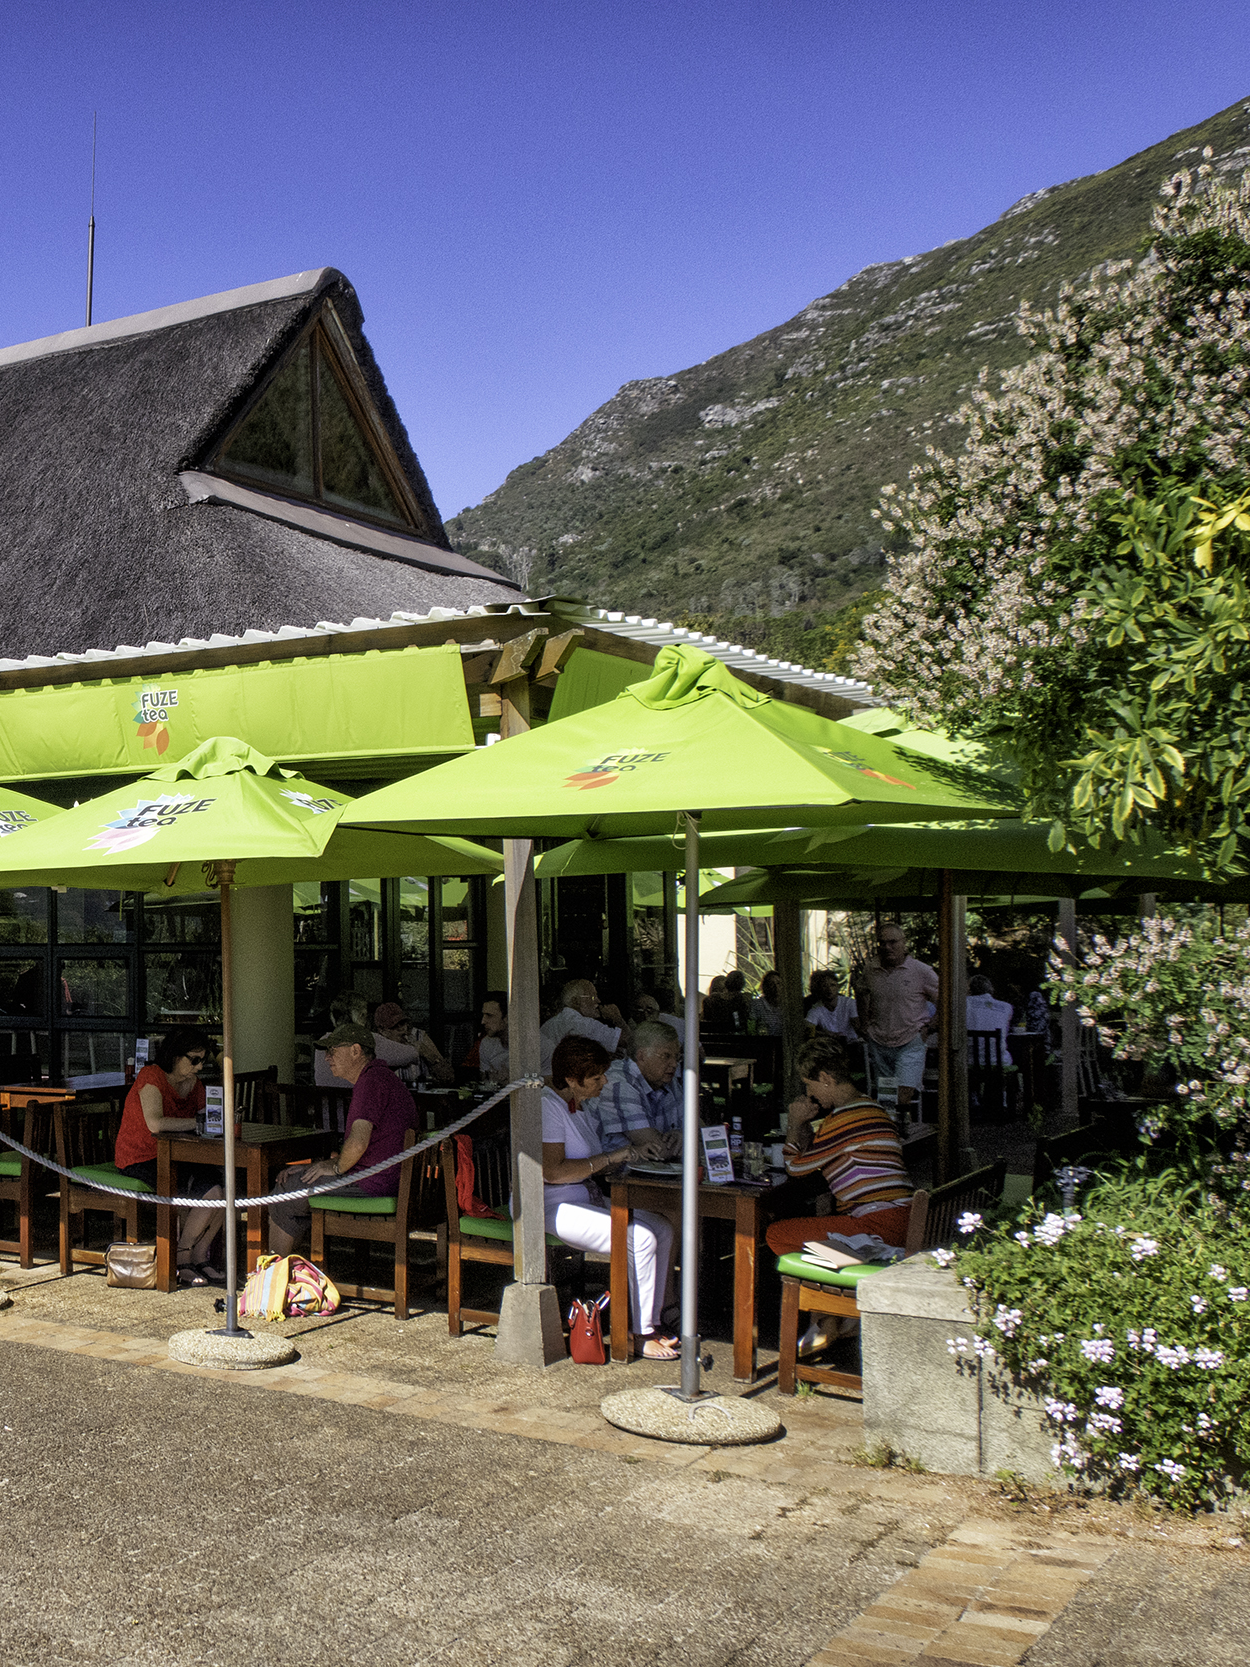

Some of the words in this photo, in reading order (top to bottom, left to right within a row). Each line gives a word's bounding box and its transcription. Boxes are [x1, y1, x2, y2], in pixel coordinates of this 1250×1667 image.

[141, 690, 178, 709] FUZE
[142, 708, 168, 722] tea
[599, 752, 671, 765] FUZE
[591, 765, 636, 773] tea
[136, 798, 217, 817] FUZE
[126, 816, 177, 828] tea
